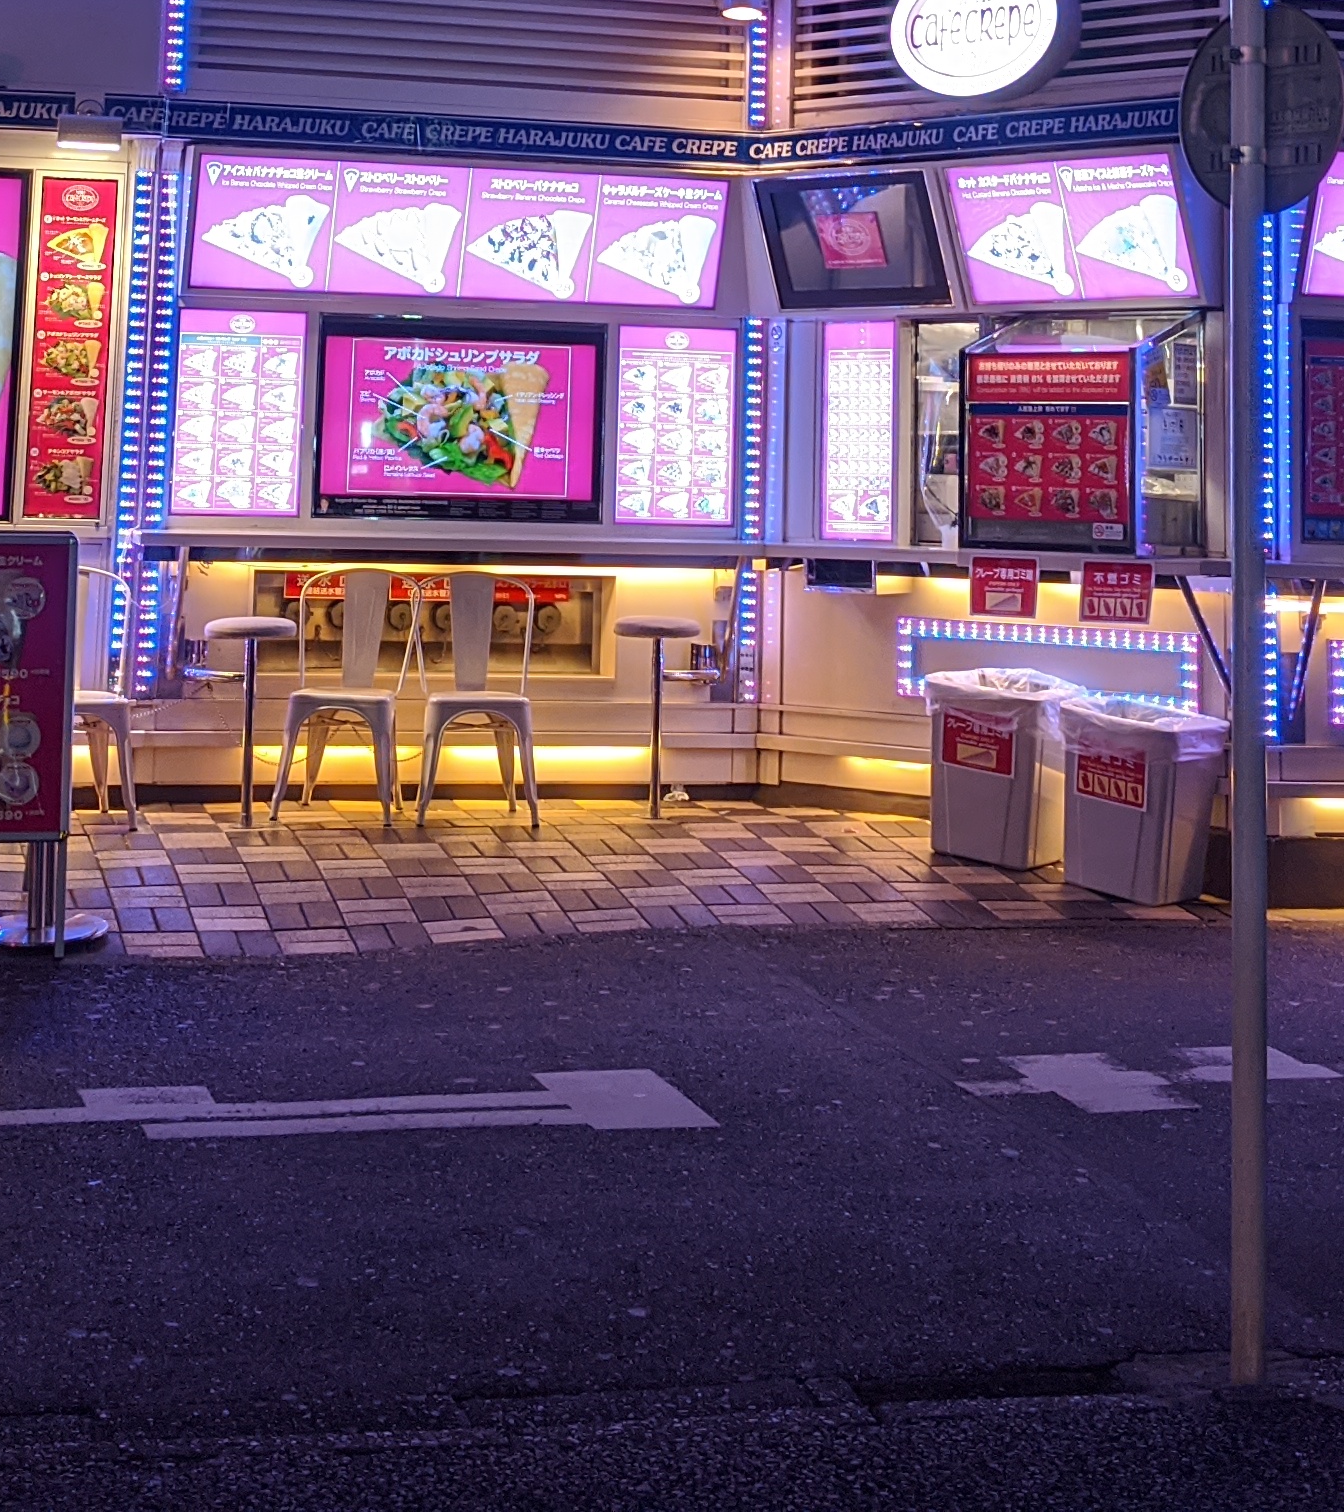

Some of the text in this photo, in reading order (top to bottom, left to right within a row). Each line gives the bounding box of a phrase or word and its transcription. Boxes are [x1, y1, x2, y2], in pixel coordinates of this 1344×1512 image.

[108, 105, 738, 157] CAFE HARAJUKU CAFE CREPE HARAJUKU CAFE CREPE
[748, 108, 1174, 159] CAFE CREPE HARAJUKU CAFE CREPE HARAJUKU
[383, 345, 541, 364] アボカドシュリンプサラダ
